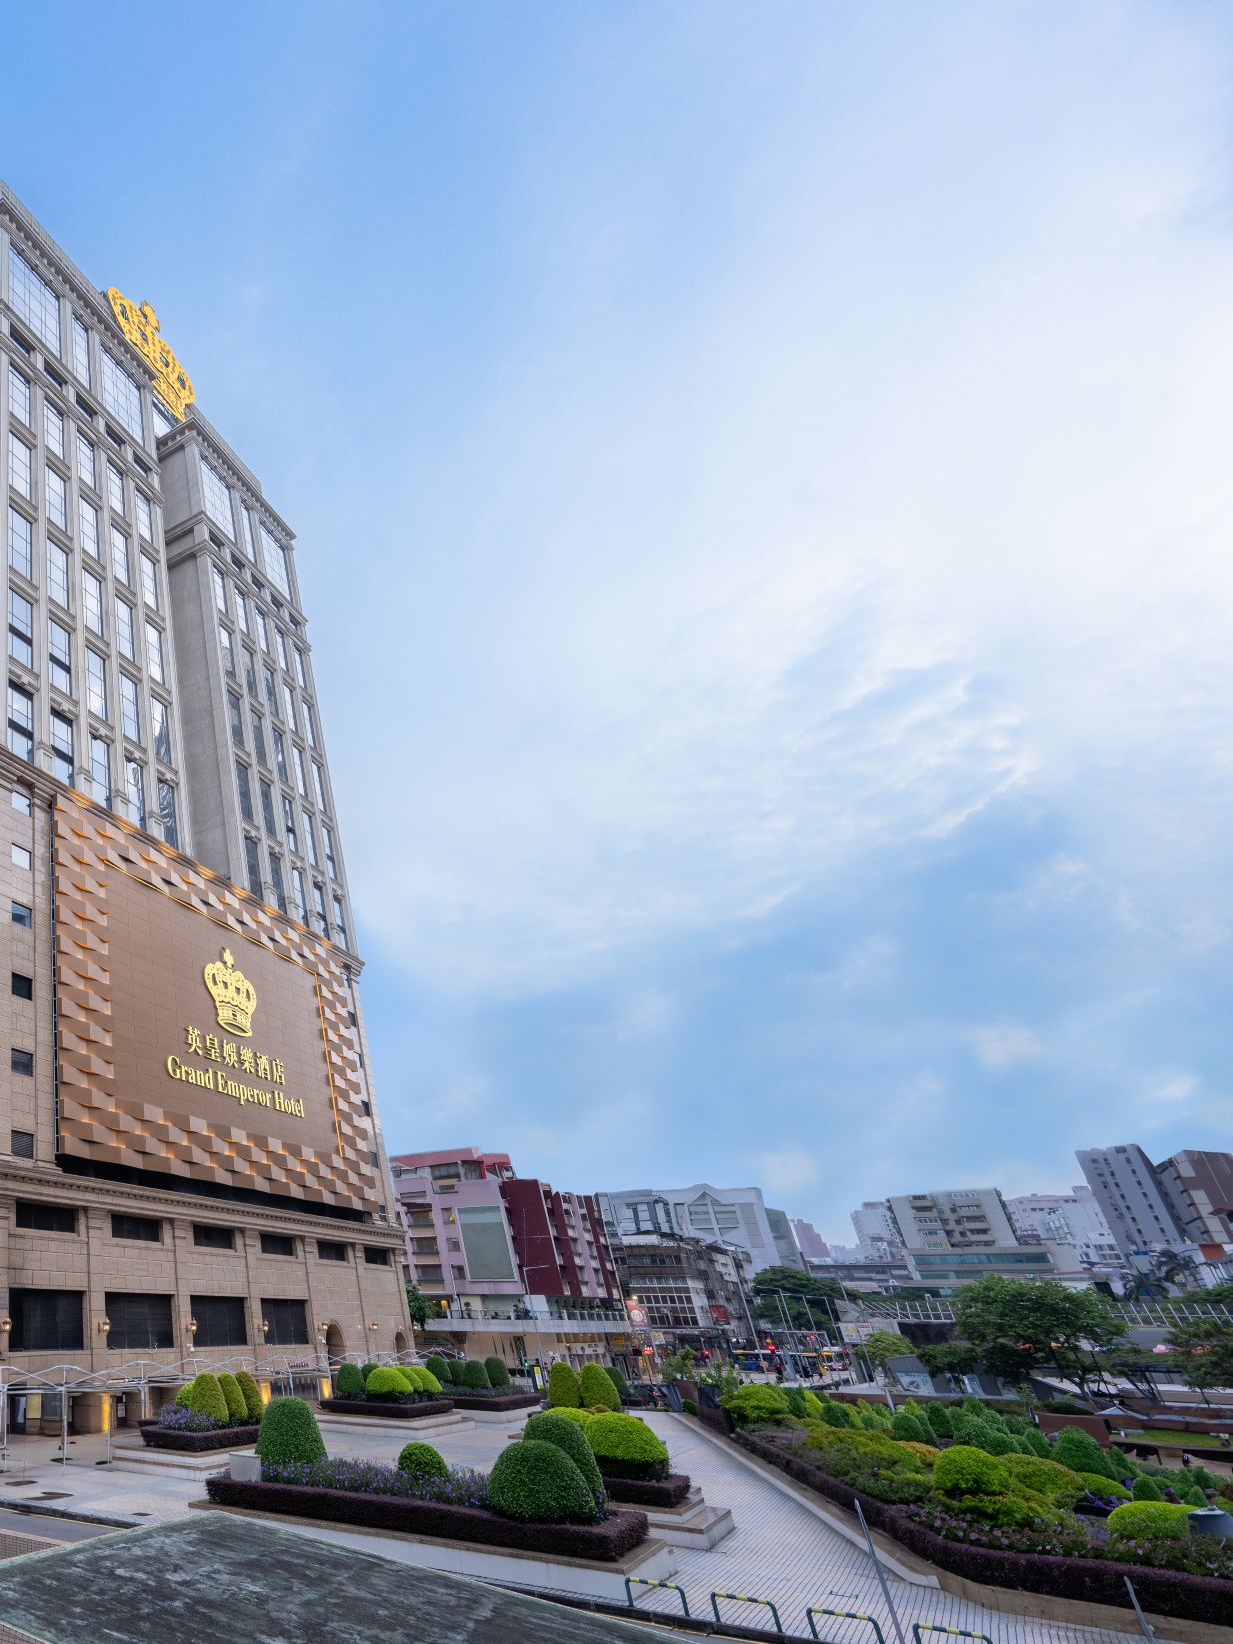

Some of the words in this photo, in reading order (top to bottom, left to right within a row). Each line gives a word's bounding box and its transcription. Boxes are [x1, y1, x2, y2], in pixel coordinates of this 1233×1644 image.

[166, 1055, 214, 1090] Grand
[216, 1070, 271, 1107] Emperor
[274, 1089, 305, 1118] Hotel
[184, 1025, 285, 1086] 英皇娛樂酒店
